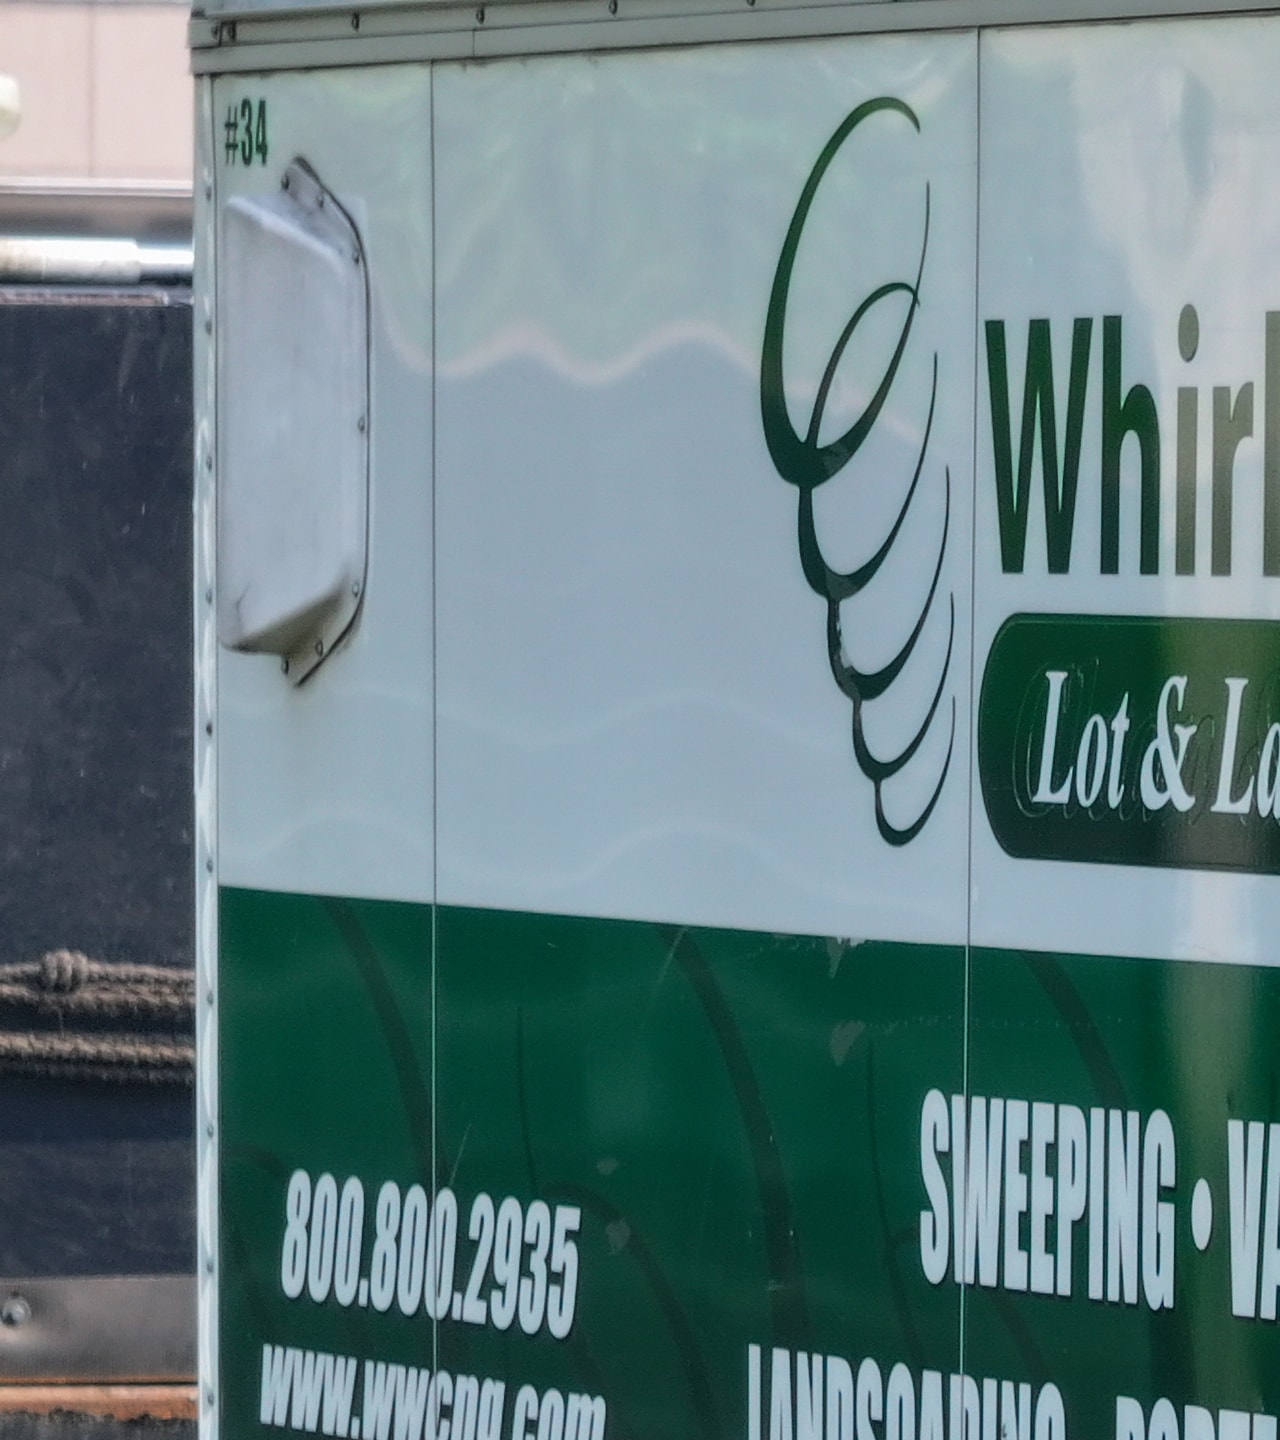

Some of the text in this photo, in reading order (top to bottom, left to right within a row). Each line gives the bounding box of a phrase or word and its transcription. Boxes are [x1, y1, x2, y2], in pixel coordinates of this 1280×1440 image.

[224, 97, 268, 166] #34
[1032, 670, 1130, 809] Lot
[1140, 675, 1197, 813] &
[281, 1168, 581, 1340] 800.800.2935
[920, 1087, 1176, 1312] SWEEPING
